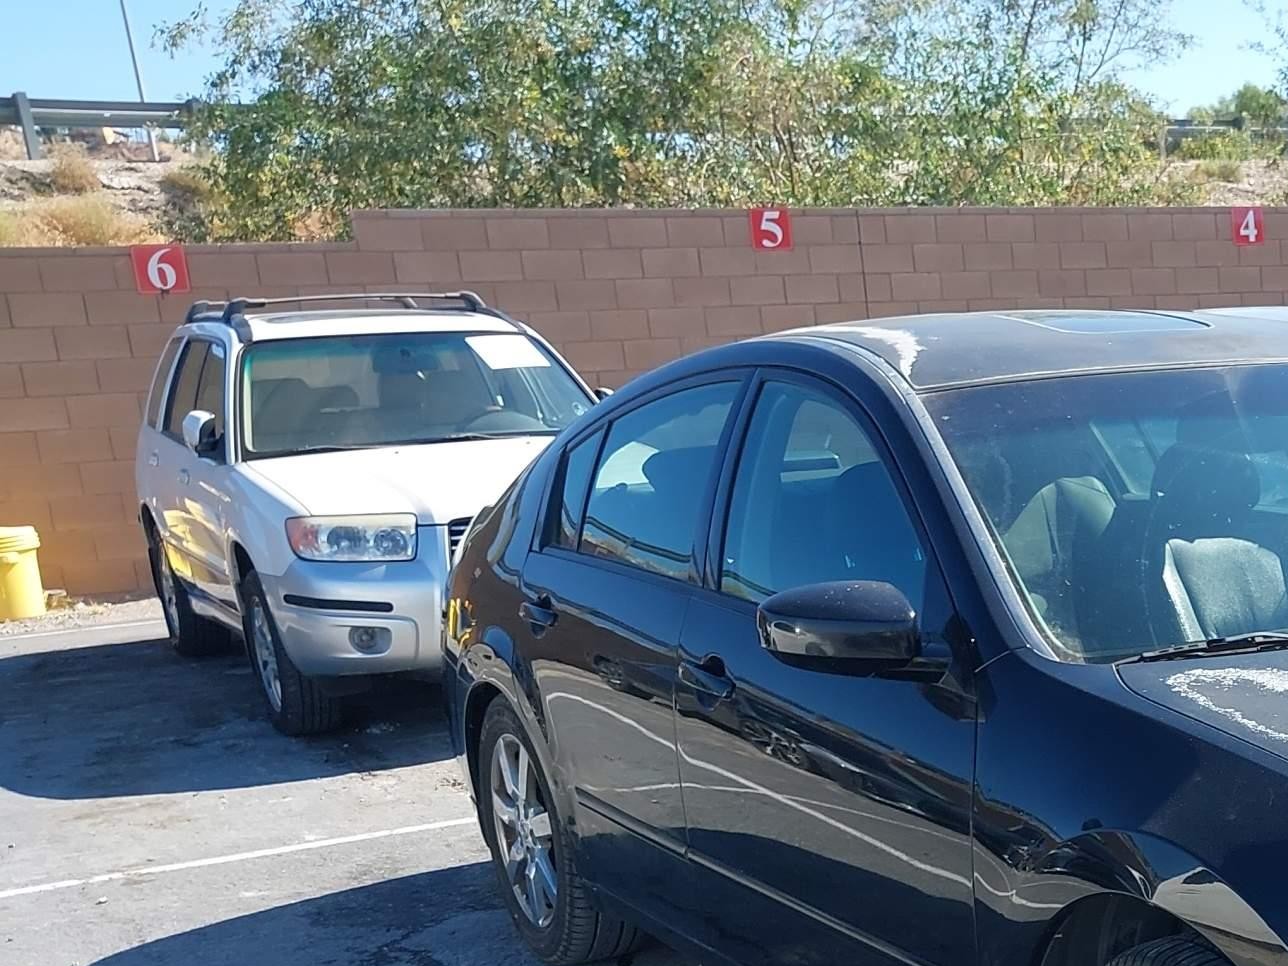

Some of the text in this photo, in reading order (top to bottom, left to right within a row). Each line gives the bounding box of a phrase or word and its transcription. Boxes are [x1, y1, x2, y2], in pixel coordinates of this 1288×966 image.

[760, 210, 784, 248] 5
[1240, 209, 1258, 242] 4
[147, 247, 177, 290] 6
